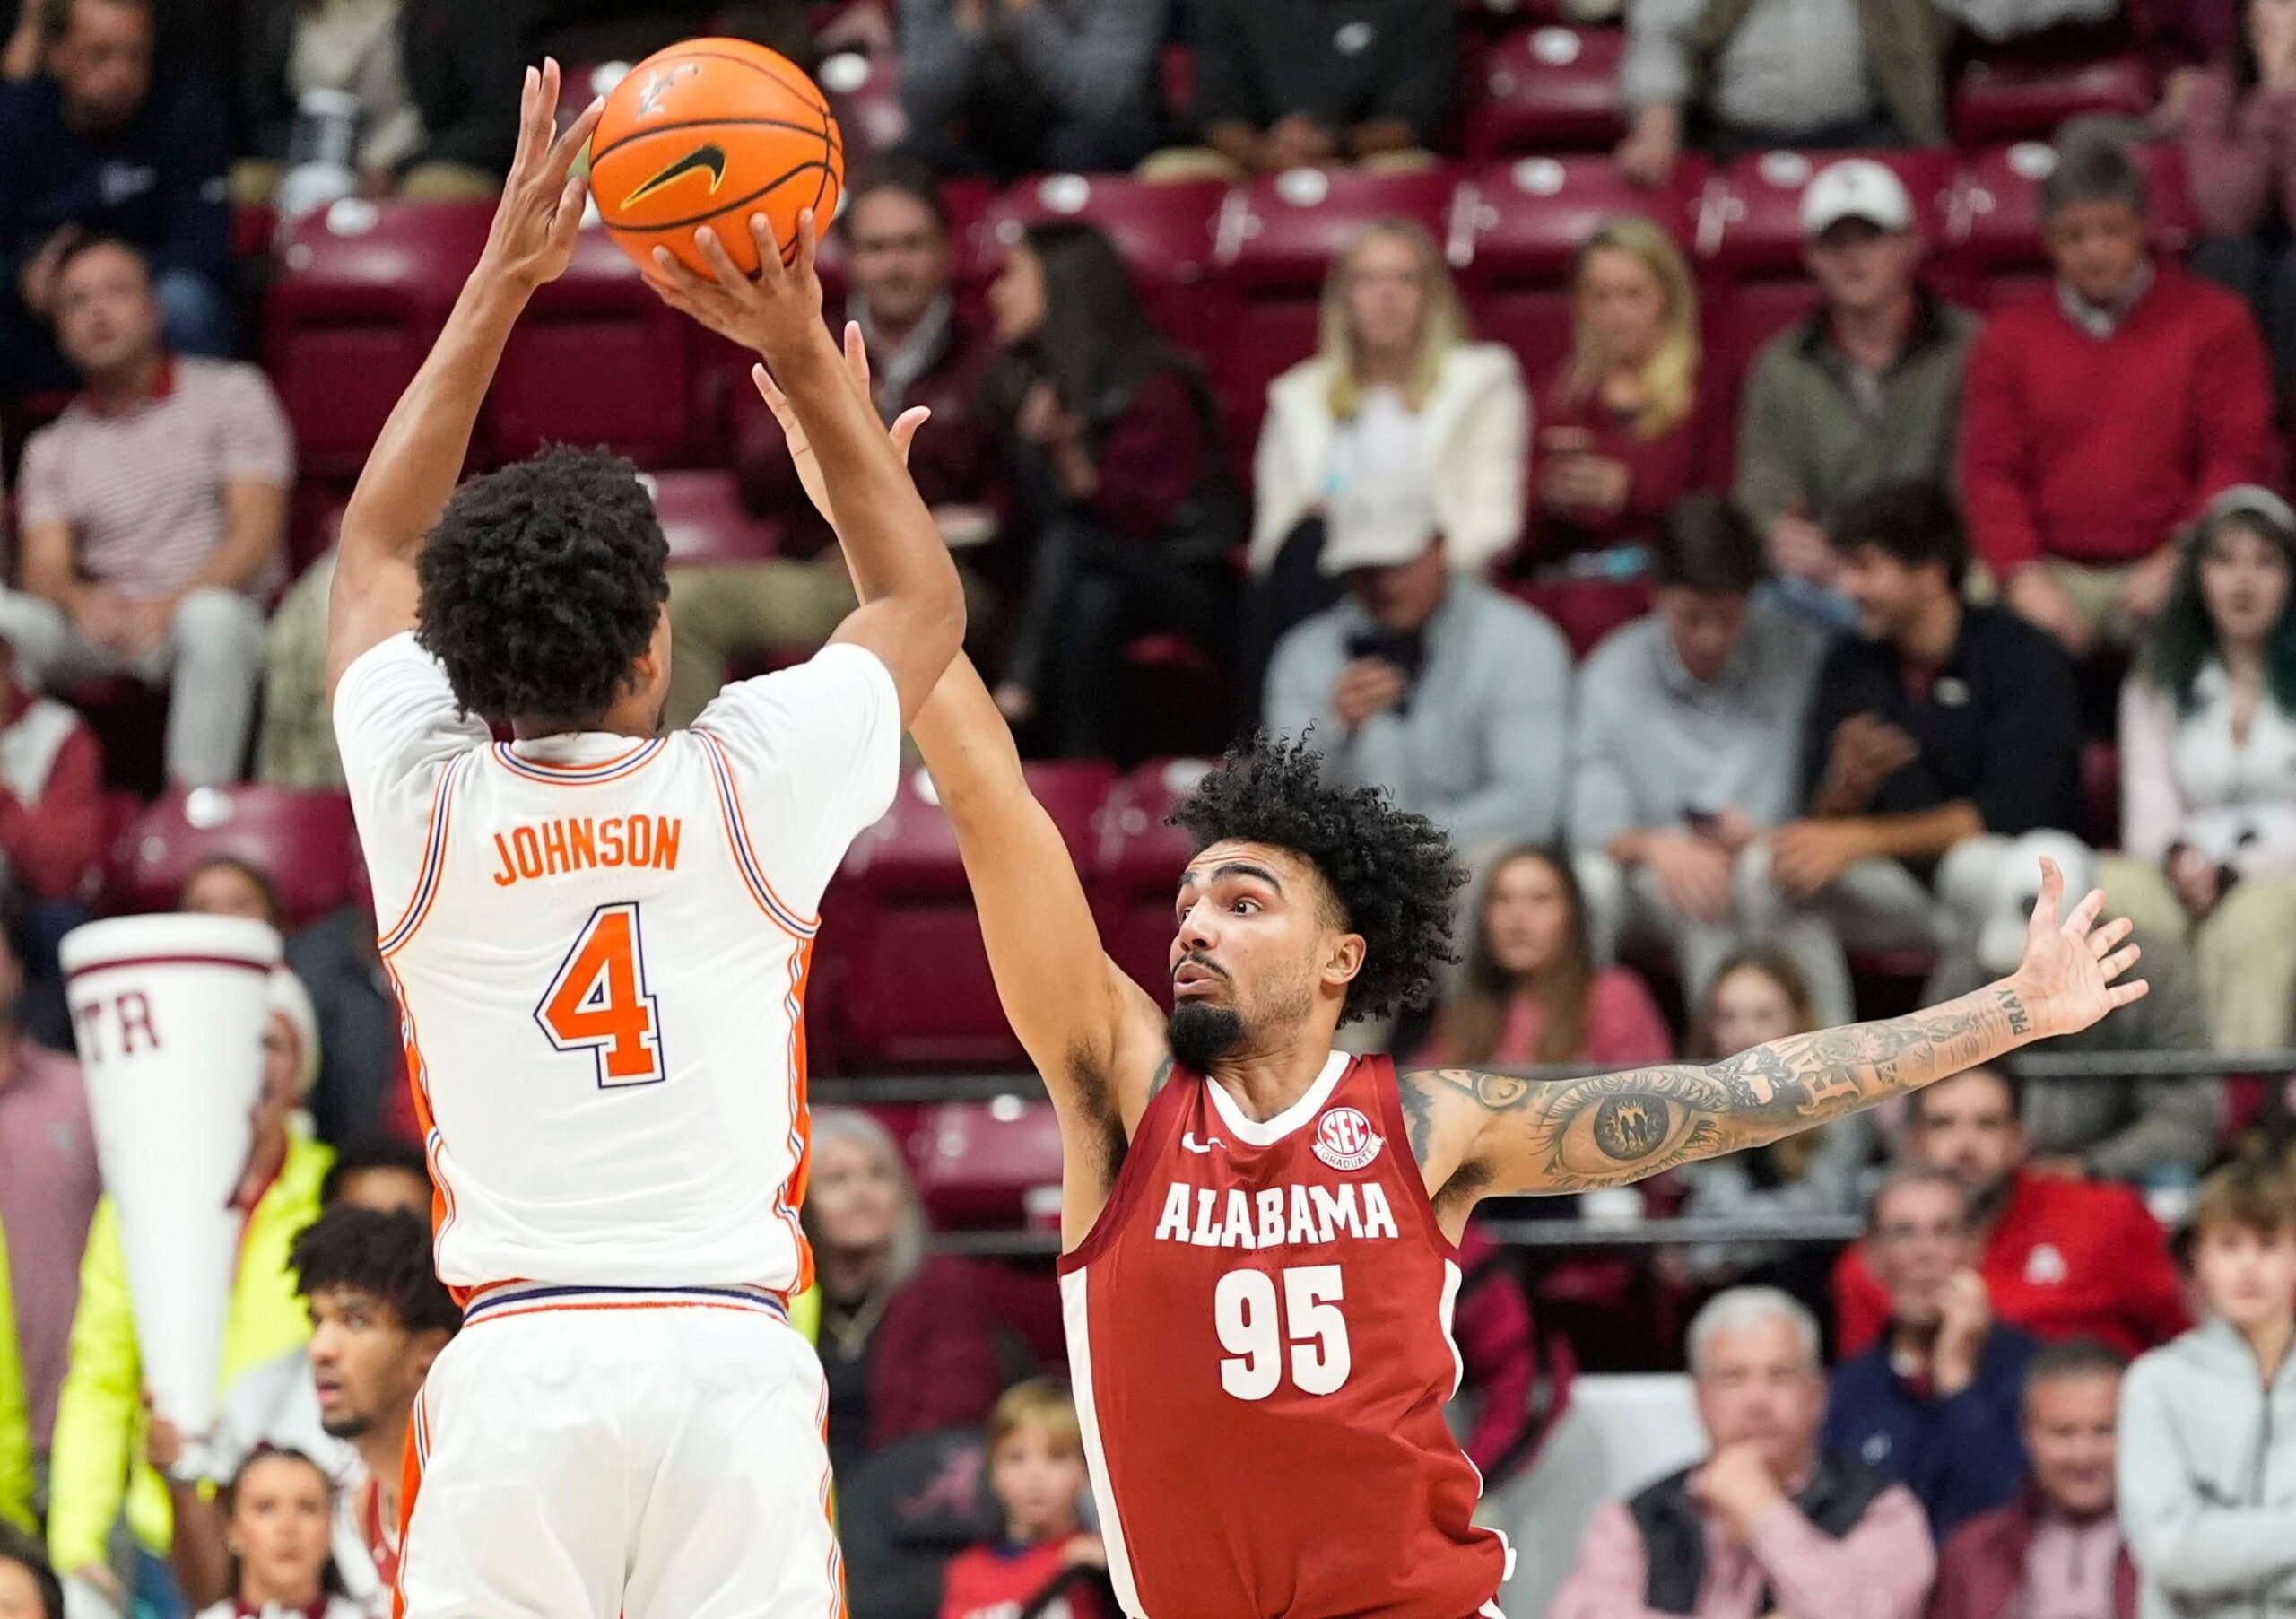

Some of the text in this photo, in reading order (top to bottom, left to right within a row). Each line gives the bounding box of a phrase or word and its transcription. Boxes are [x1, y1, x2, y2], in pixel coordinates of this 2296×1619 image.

[493, 814, 682, 887] JOHNSON
[534, 901, 665, 1090] 4
[1994, 988, 2031, 1036] PRAY
[1320, 1110, 1369, 1154] SEC
[1321, 1148, 1376, 1169] GRADUATE
[1154, 1181, 1399, 1249] ALABAMA
[1214, 1264, 1352, 1401] 95
